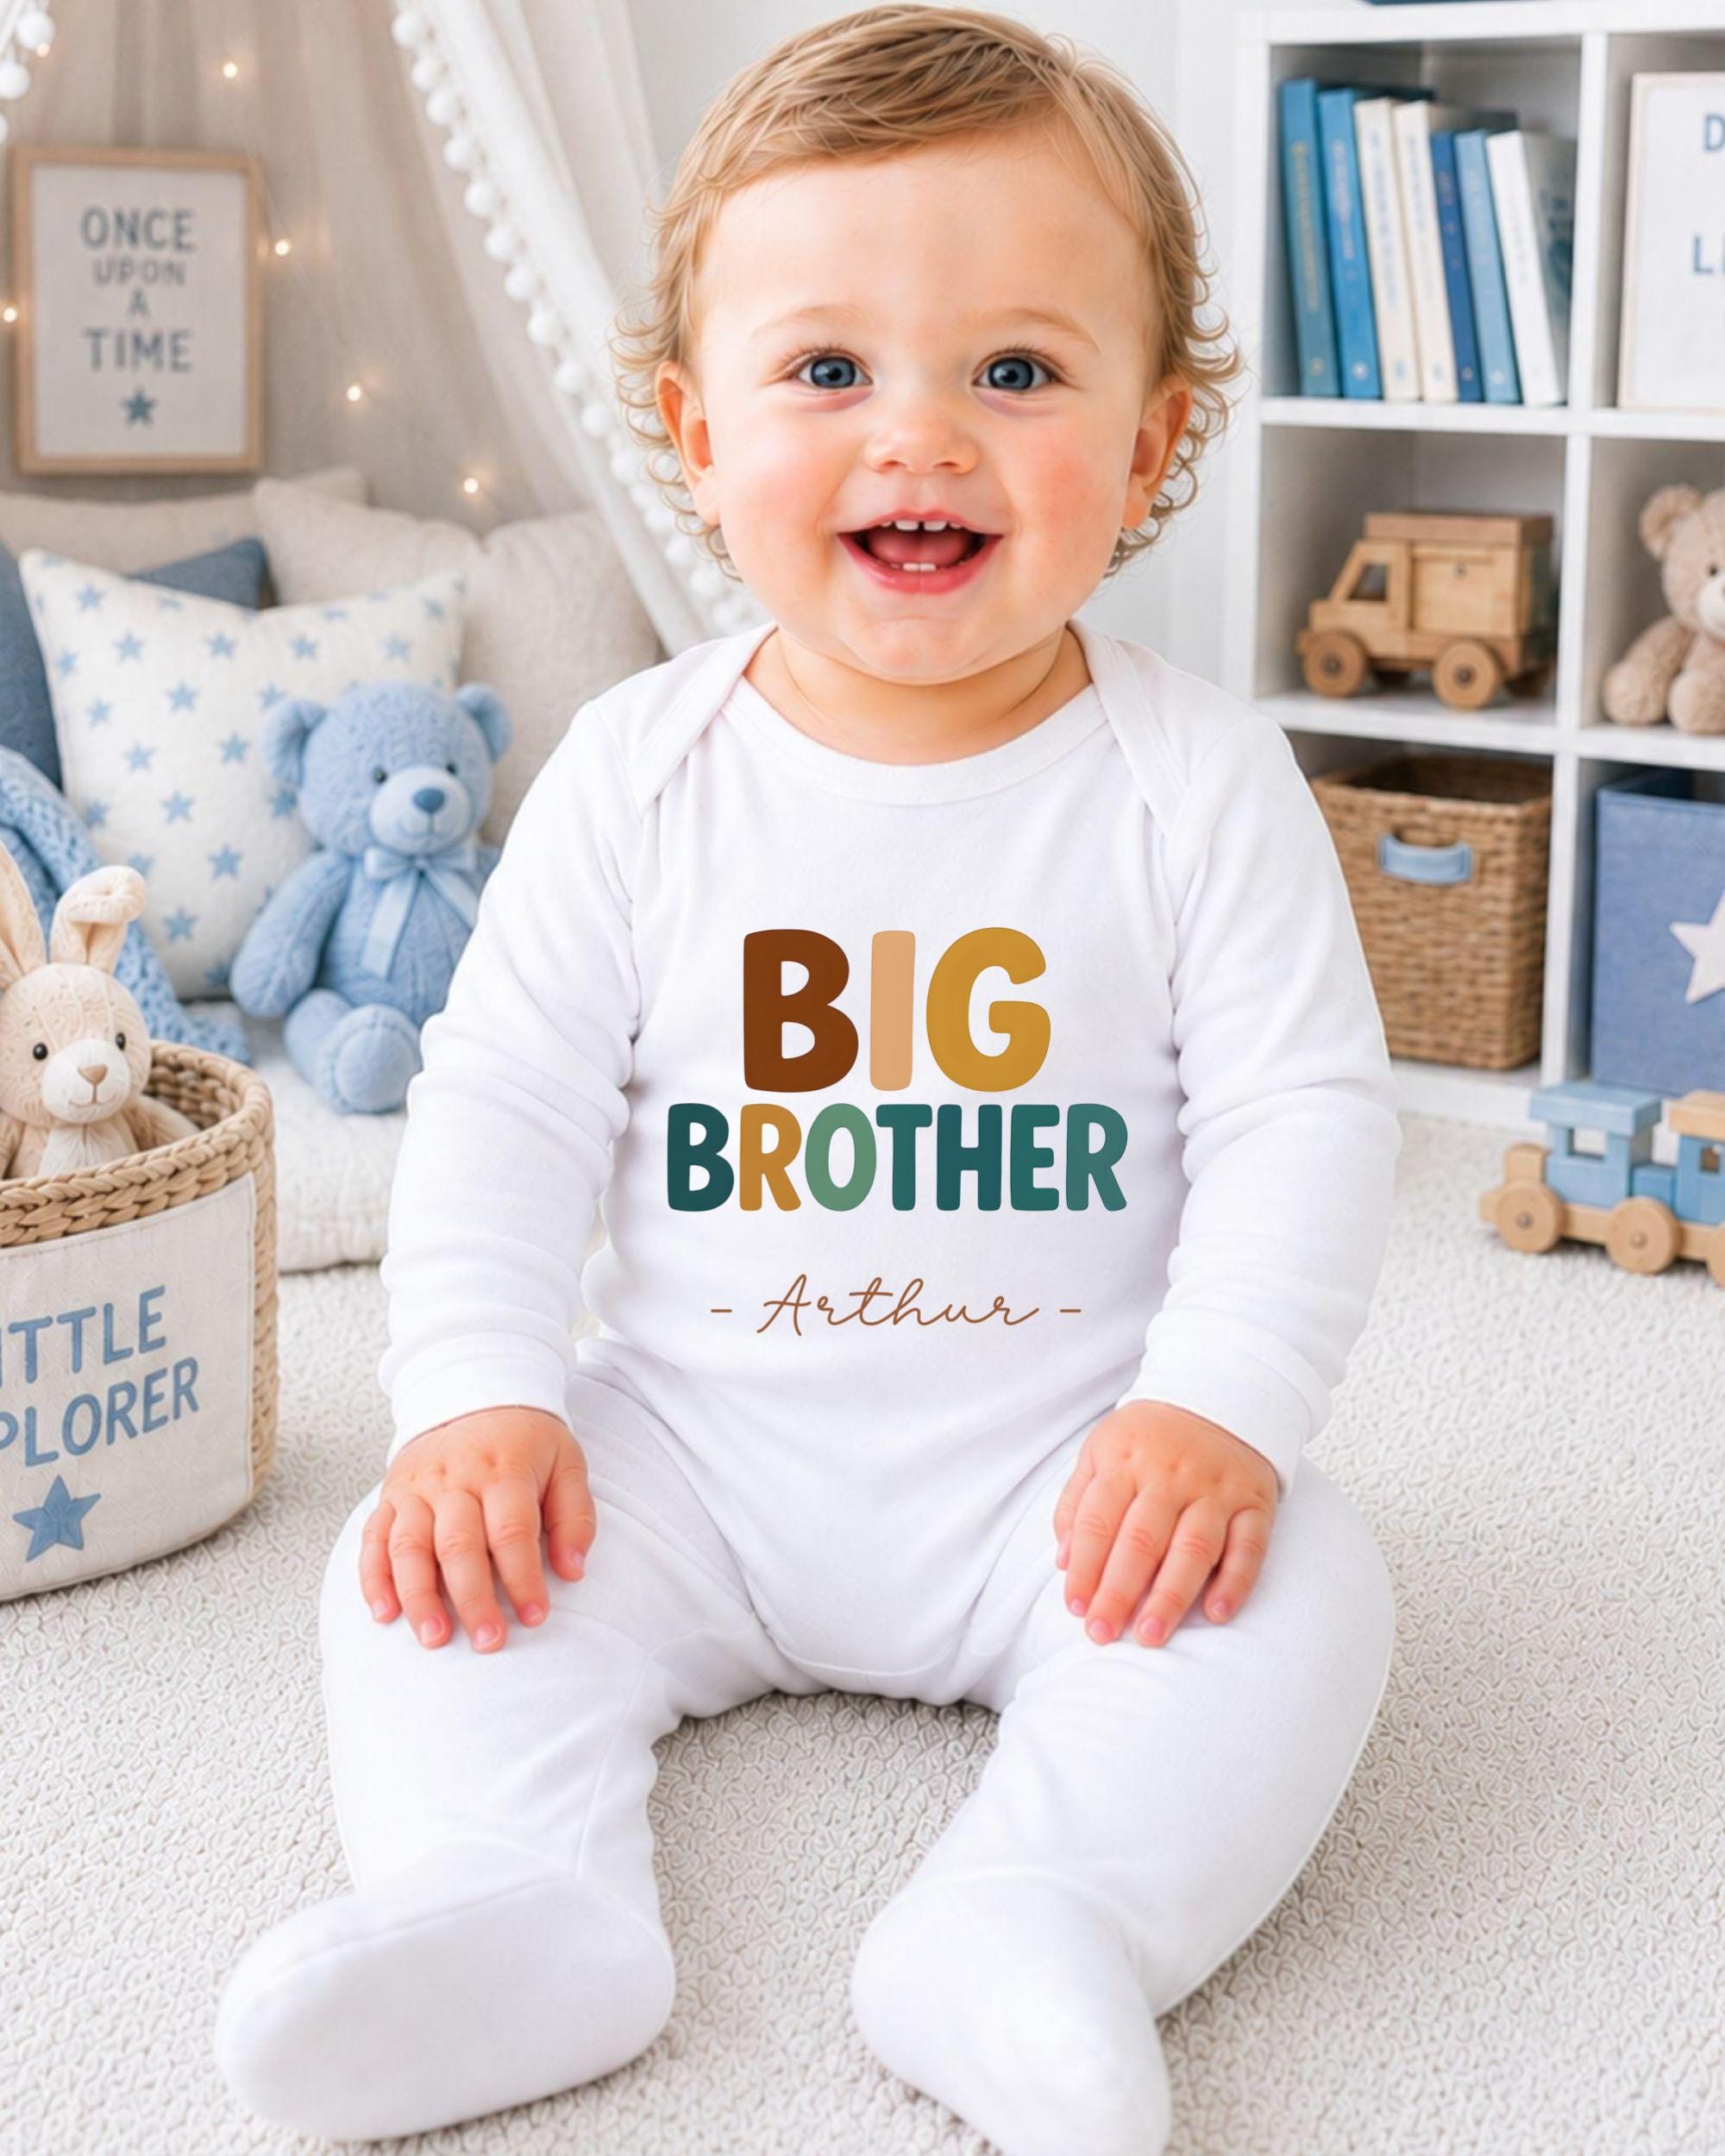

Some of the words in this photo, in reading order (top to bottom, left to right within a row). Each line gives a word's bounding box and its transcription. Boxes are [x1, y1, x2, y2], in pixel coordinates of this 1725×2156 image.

[81, 207, 196, 252] ONCE
[93, 258, 185, 285] UPON
[1692, 235, 1725, 274] L
[129, 288, 150, 317] A
[84, 327, 193, 373] TIME
[743, 927, 1051, 1093] BIG
[667, 1103, 1127, 1212] BROTHER
[756, 1274, 1039, 1336] Arthur
[0, 1285, 166, 1388] TTLE
